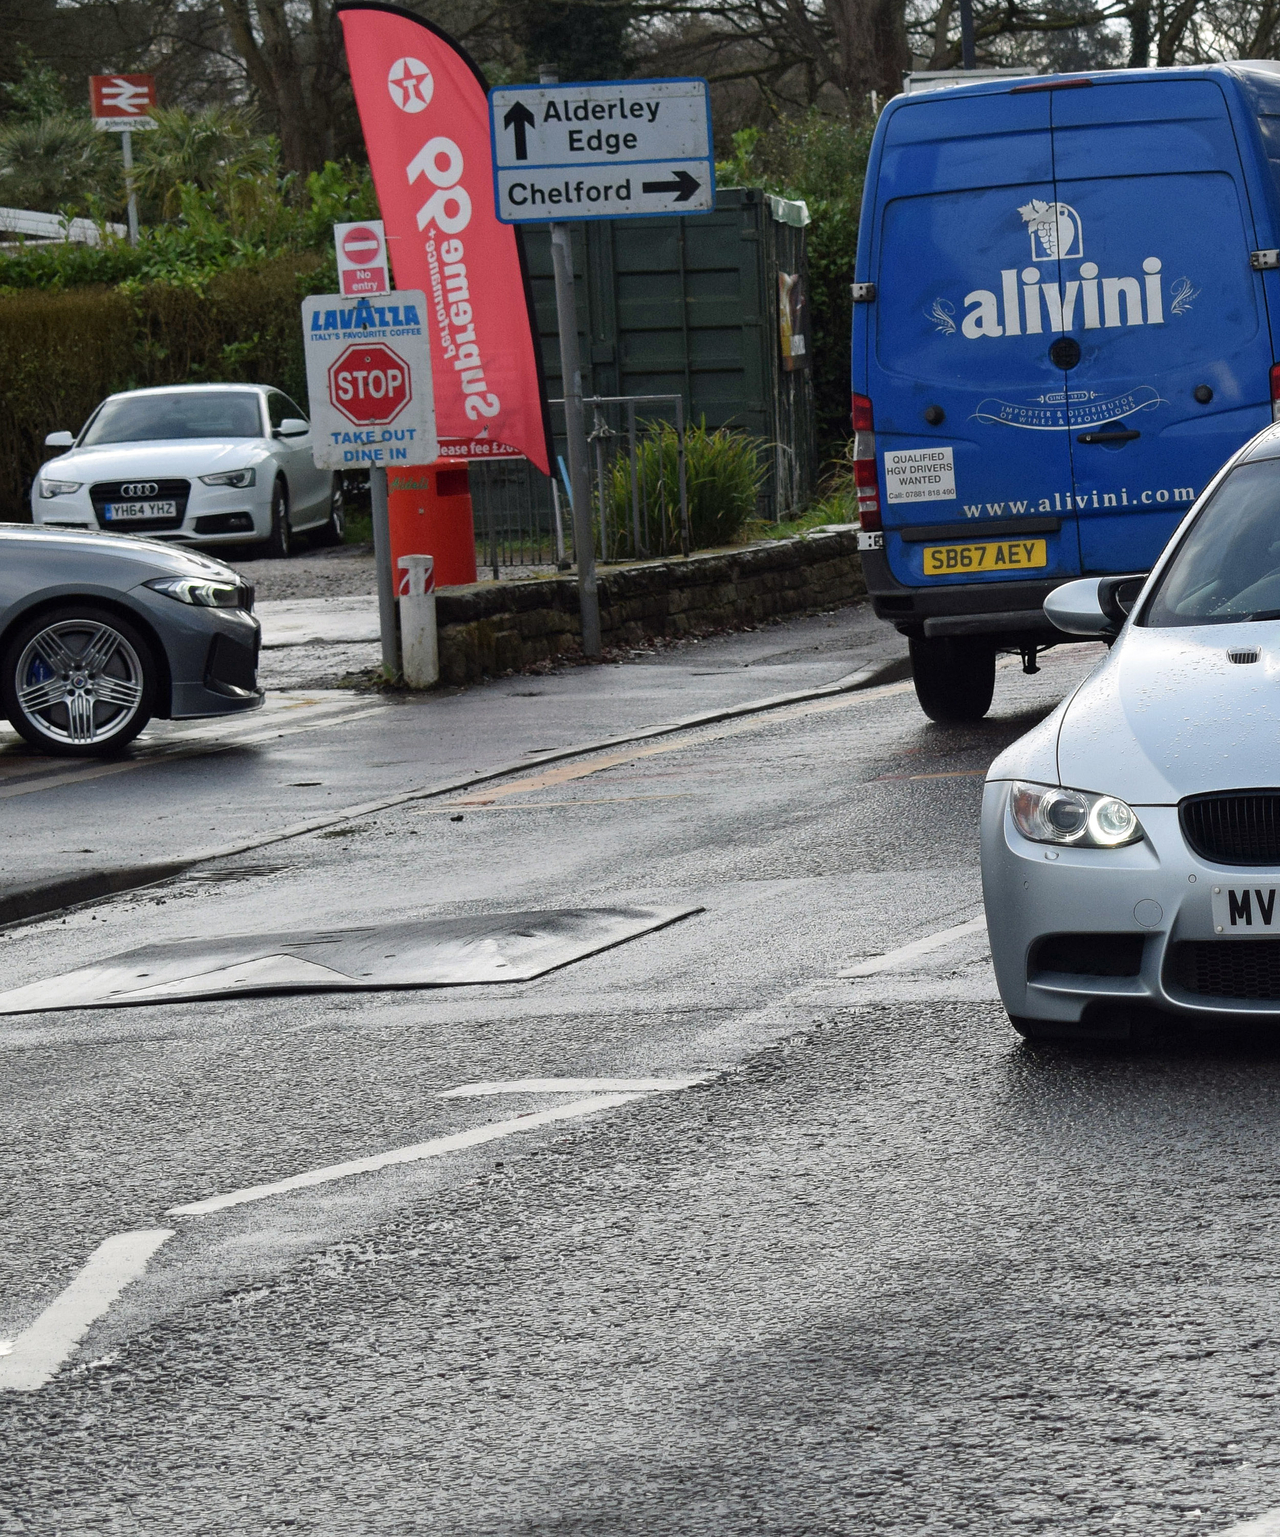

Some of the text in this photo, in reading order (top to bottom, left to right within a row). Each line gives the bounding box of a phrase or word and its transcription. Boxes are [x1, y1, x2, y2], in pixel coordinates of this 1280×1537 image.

[544, 97, 660, 123] Alderley
[568, 129, 638, 155] Edge
[508, 178, 632, 206] Chelford
[356, 270, 372, 279] No
[352, 281, 378, 292] entry
[961, 256, 1165, 340] alivini
[310, 299, 420, 332] LAVAZZA
[311, 328, 422, 342] ITALY'S FAVOURITE COFFEE
[337, 369, 403, 401] STOP
[1000, 412, 1013, 420] OF
[1019, 416, 1053, 425] WINES
[1070, 402, 1136, 424] PROVISIONS
[1001, 406, 1051, 418] IMPORTER
[1068, 395, 1135, 417] DISTRIBUTOR
[331, 428, 417, 445] TAKE OUT
[344, 448, 407, 462] DINE IN
[438, 444, 468, 456] lease
[470, 442, 490, 454] fee
[892, 452, 945, 464] QUALIFIED
[886, 462, 953, 476] HGV DRIVERS
[898, 474, 942, 486] WANTED
[888, 492, 904, 500] Call:
[906, 490, 926, 498] 07881
[942, 488, 955, 496] 490
[963, 485, 1197, 519] www.alivini.com
[113, 502, 174, 517] YH64 YHZ
[930, 542, 1036, 570] SB67 AEY
